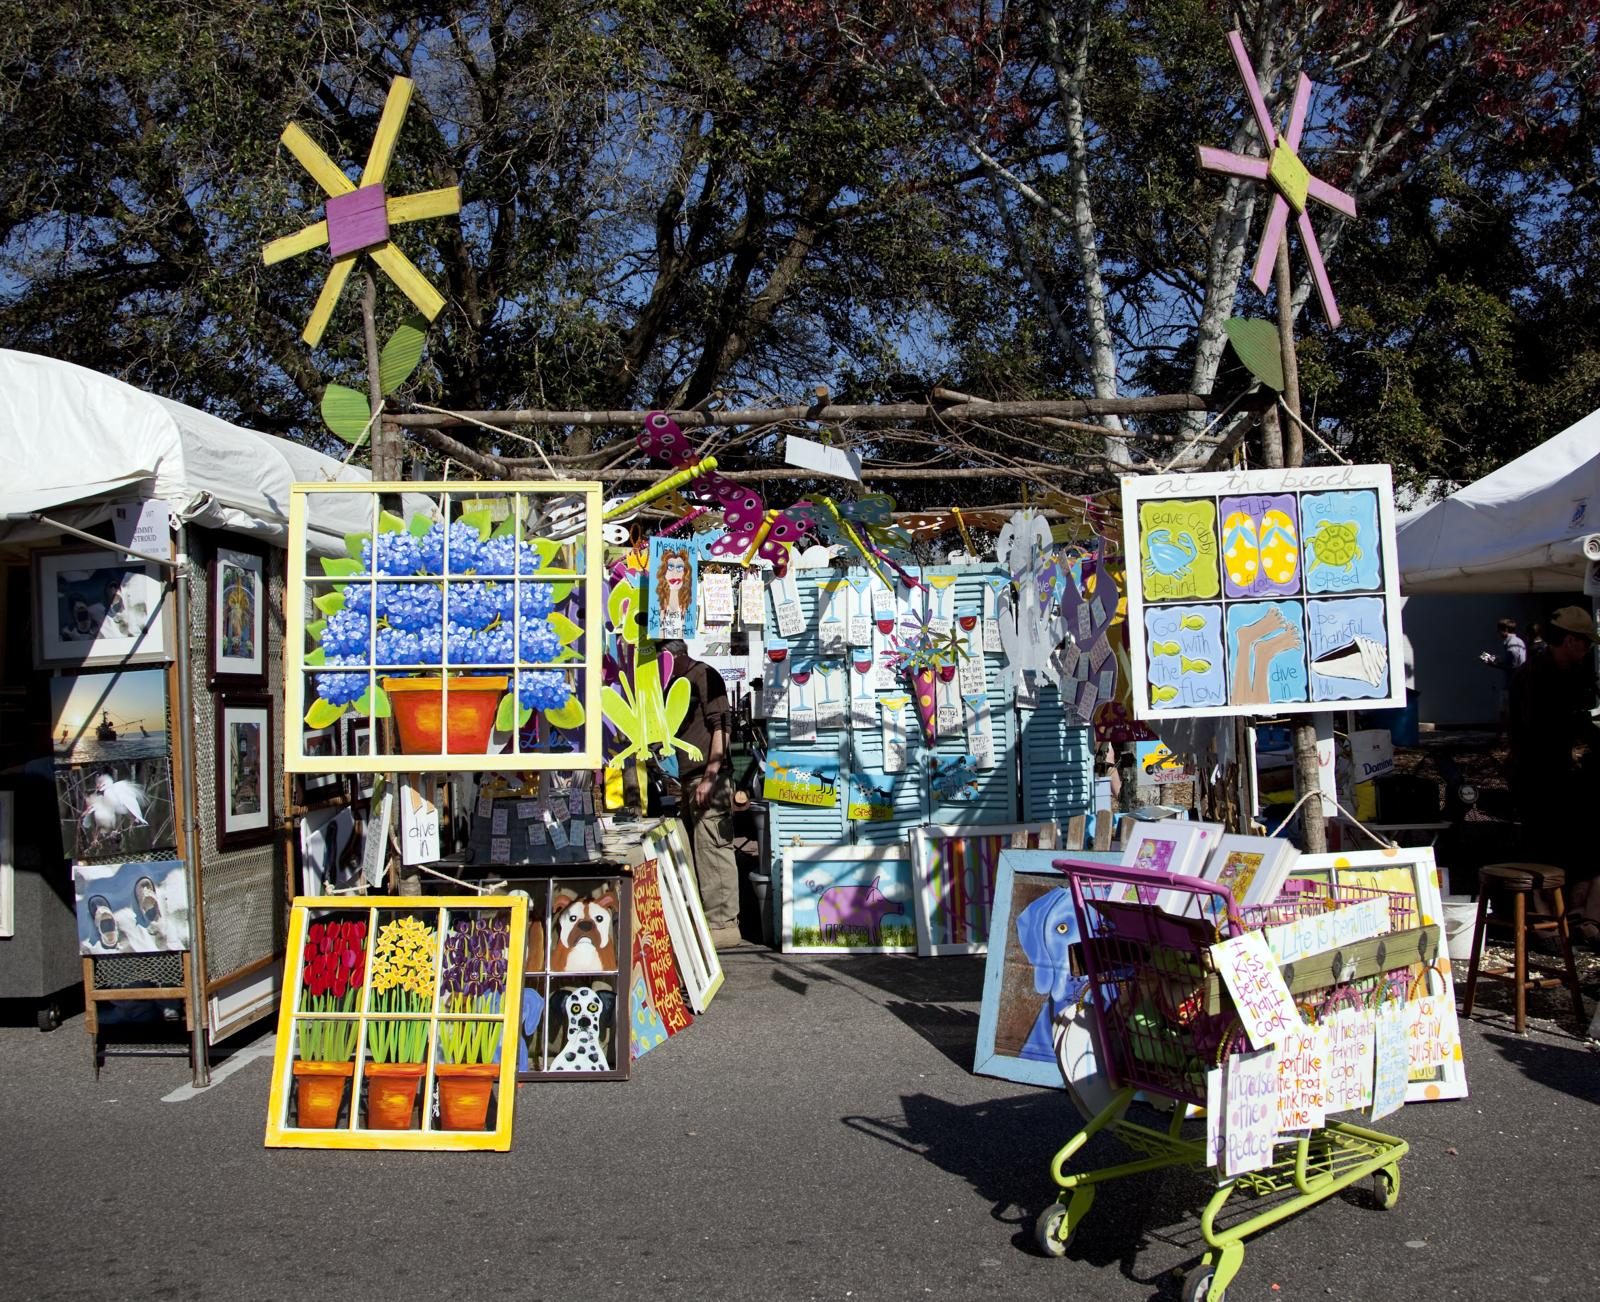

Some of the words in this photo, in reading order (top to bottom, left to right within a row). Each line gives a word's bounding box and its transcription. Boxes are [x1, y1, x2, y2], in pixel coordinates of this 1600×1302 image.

[1154, 477, 1202, 494] at
[1218, 471, 1271, 492] the
[1152, 575, 1197, 597] behind
[1316, 604, 1337, 625] be
[1152, 617, 1178, 637] Go
[1181, 632, 1211, 654] with
[1154, 660, 1180, 683] the
[1271, 663, 1299, 683] dive
[1280, 683, 1292, 699] in
[408, 814, 436, 839] dive
[419, 839, 430, 858] in
[1230, 941, 1247, 958] I
[650, 954, 673, 978] make
[654, 975, 666, 997] my
[1233, 971, 1274, 1000] better
[655, 983, 683, 1019] friends
[1243, 996, 1271, 1021] than
[669, 1008, 689, 1034] fat
[1301, 1053, 1322, 1076] like
[1331, 1060, 1359, 1081] color
[1301, 1092, 1324, 1109] more
[1238, 1101, 1261, 1129] the
